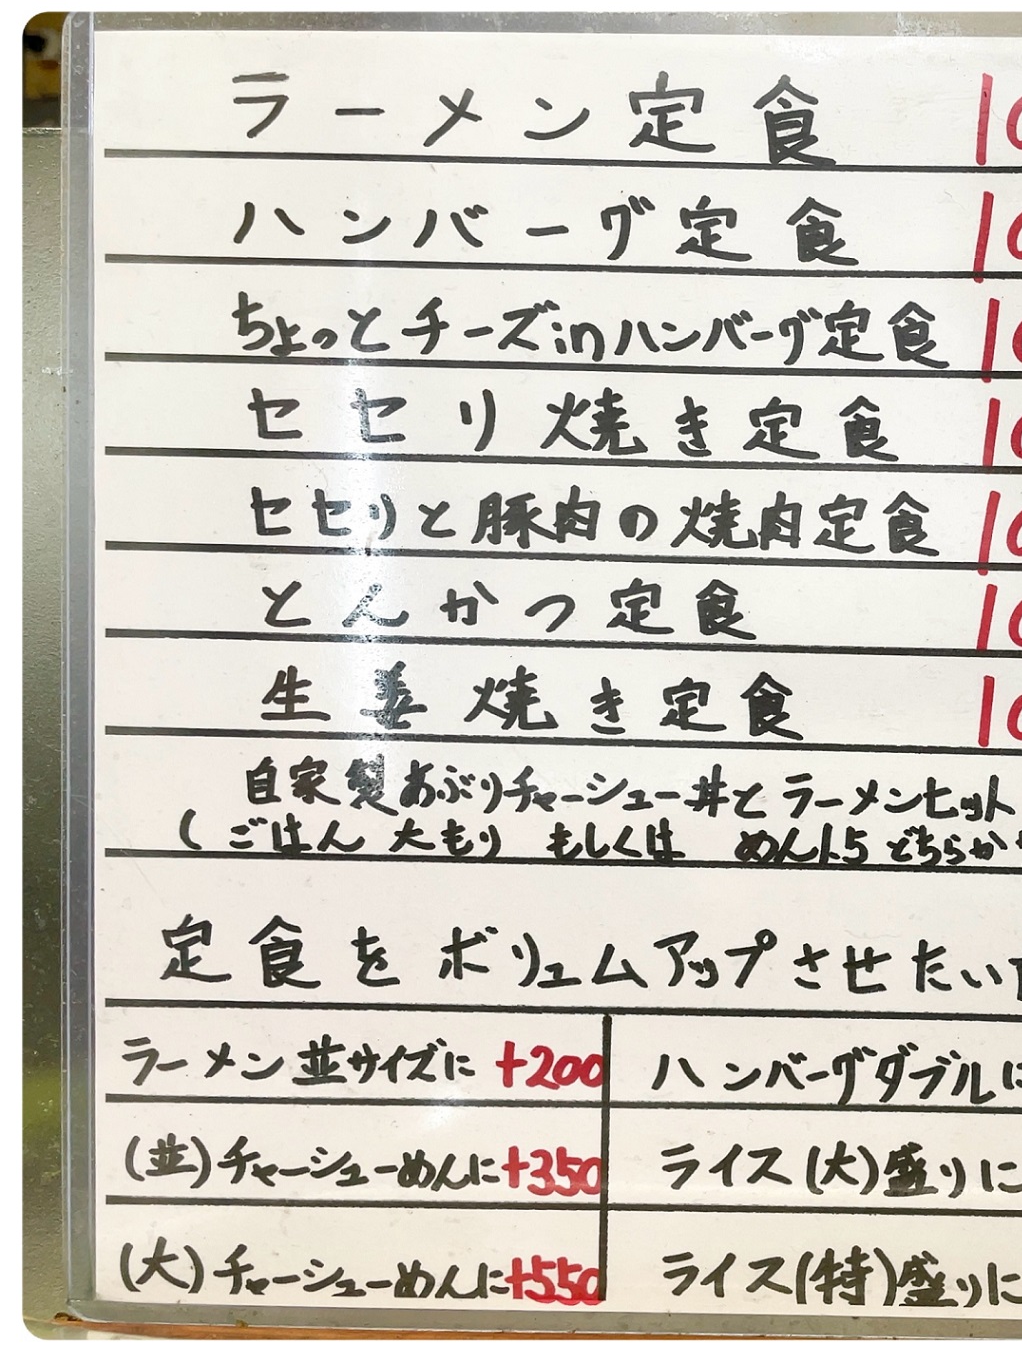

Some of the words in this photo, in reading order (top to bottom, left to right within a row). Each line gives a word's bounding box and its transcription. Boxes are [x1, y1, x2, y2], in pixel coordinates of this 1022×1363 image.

[232, 70, 836, 166] ラーメン定食
[233, 195, 859, 266] ハンバーグ定食
[232, 291, 950, 369] ちょっとチーズinハンバーグ定食
[247, 387, 899, 463] セセリ焼き定食
[250, 484, 939, 556] セセリと豚肉の焼肉定食
[262, 577, 757, 640] とんかつ定食
[260, 661, 804, 741] 生姜焼き定食
[121, 1034, 477, 1086] ラーメン並サイズに
[496, 1040, 605, 1091] +200
[124, 1133, 500, 1191] (並)チャーシューめんに
[502, 1145, 603, 1197] +350
[119, 1236, 509, 1300] (大)チャーシューめんに
[505, 1254, 602, 1306] +550
